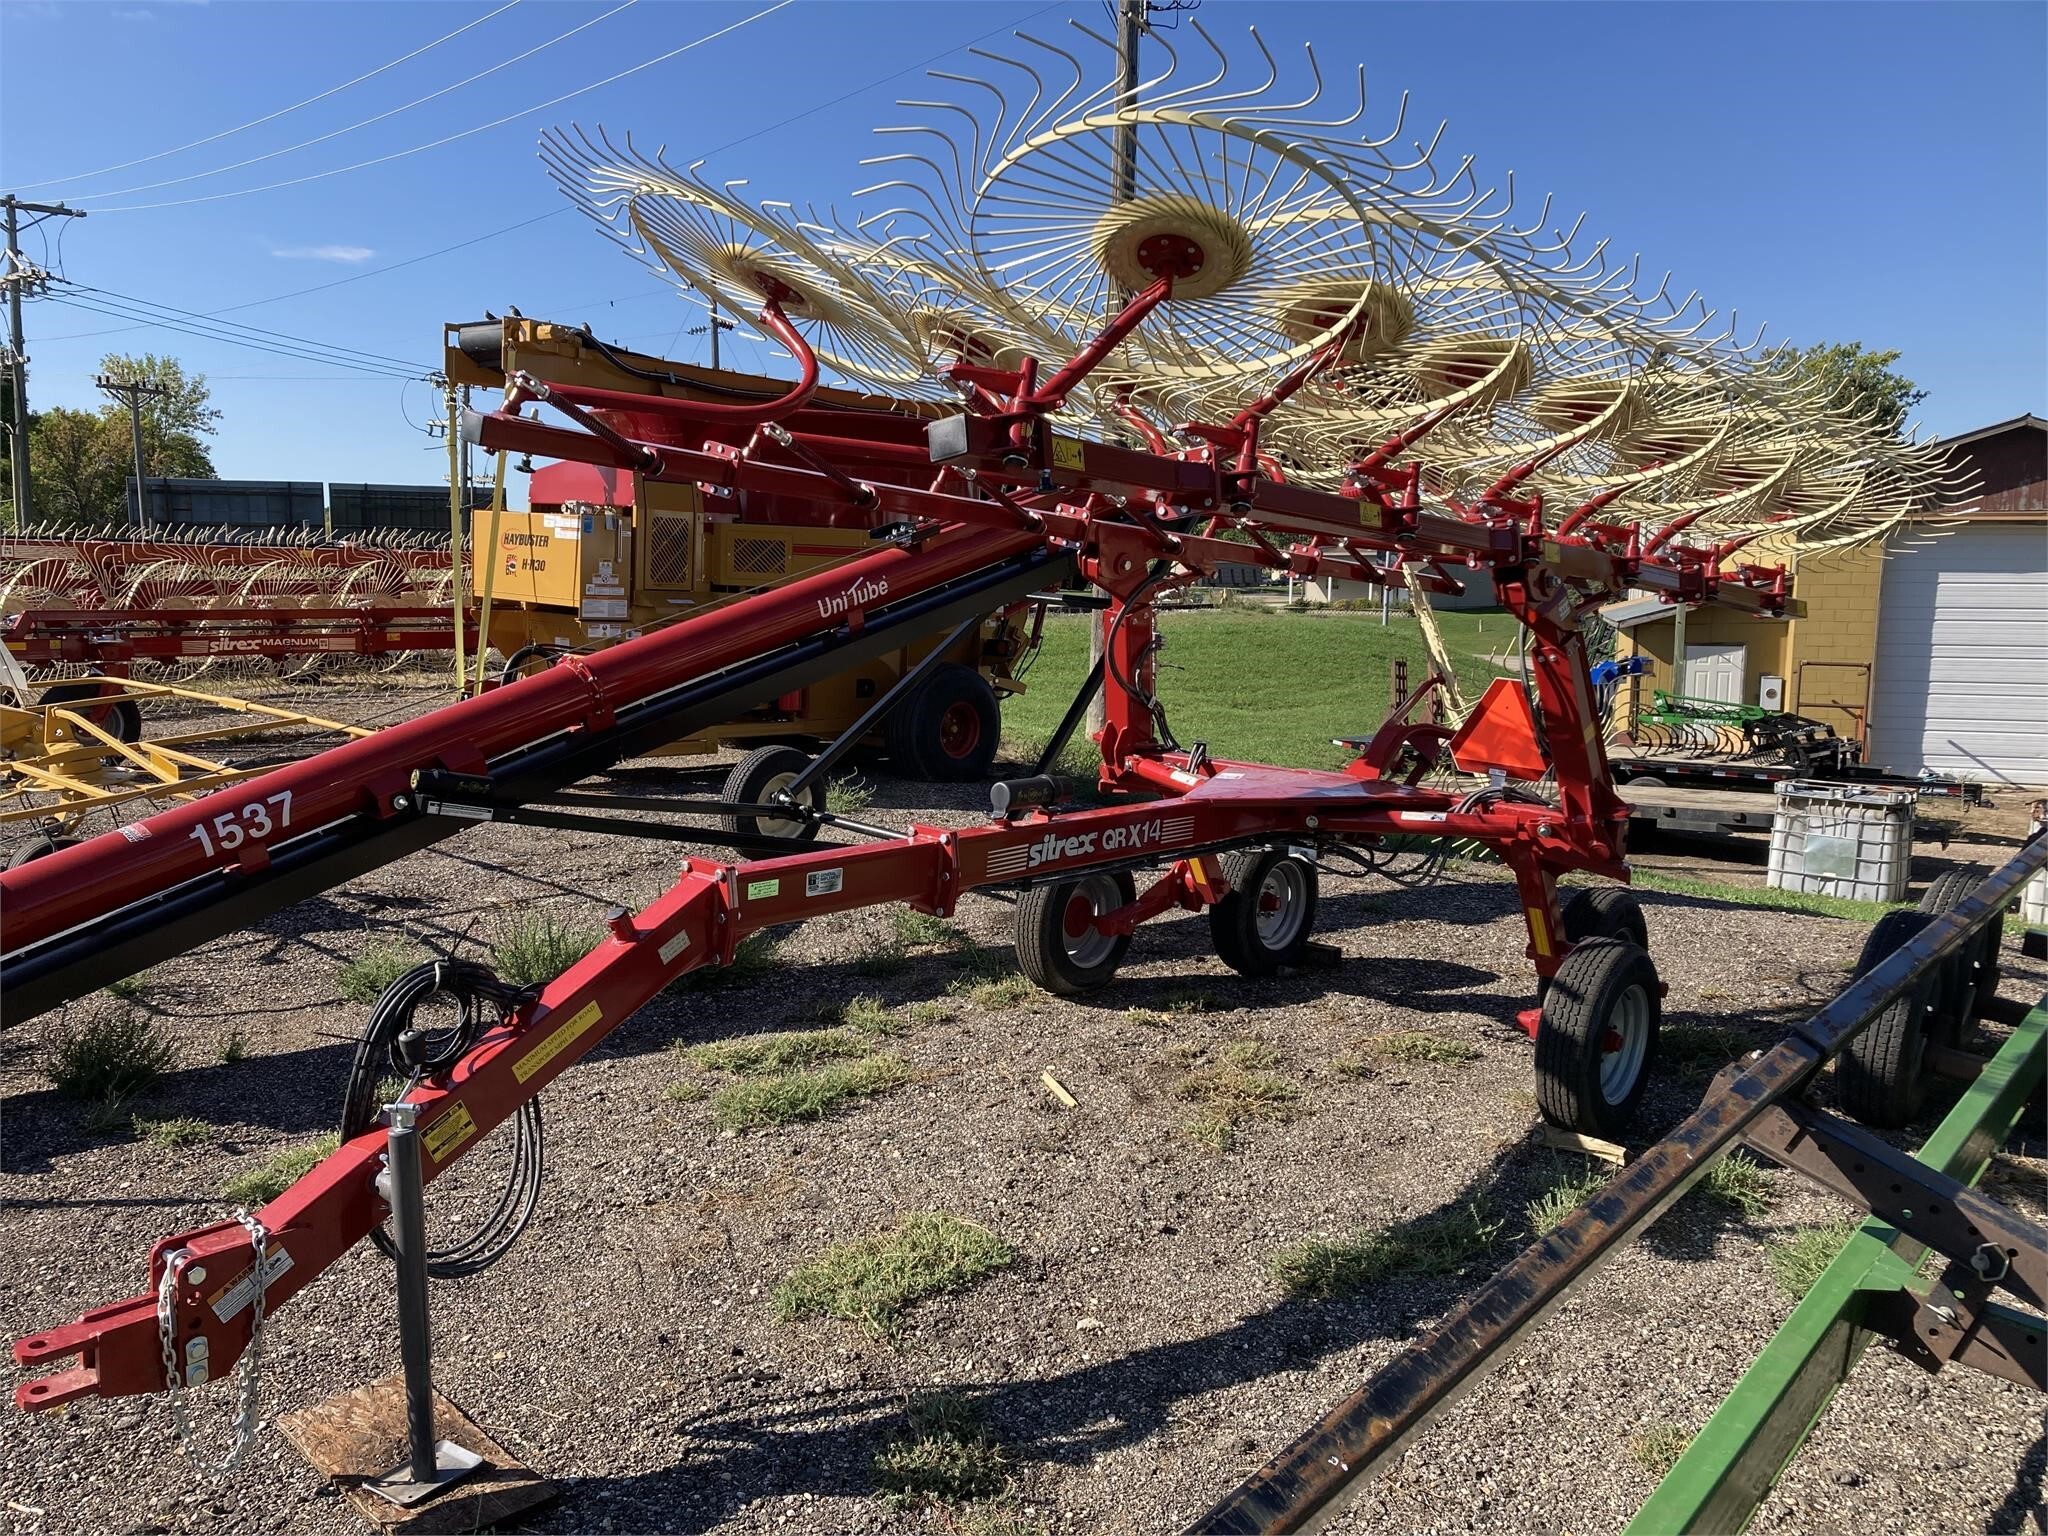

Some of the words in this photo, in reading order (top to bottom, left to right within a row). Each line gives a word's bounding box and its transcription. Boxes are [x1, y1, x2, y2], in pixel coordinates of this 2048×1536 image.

[503, 532, 549, 547] HAYBUSTER
[210, 637, 261, 652] sitrex
[263, 638, 319, 646] MAGNUM
[189, 790, 292, 858] 1537
[1028, 831, 1098, 867] sitrex
